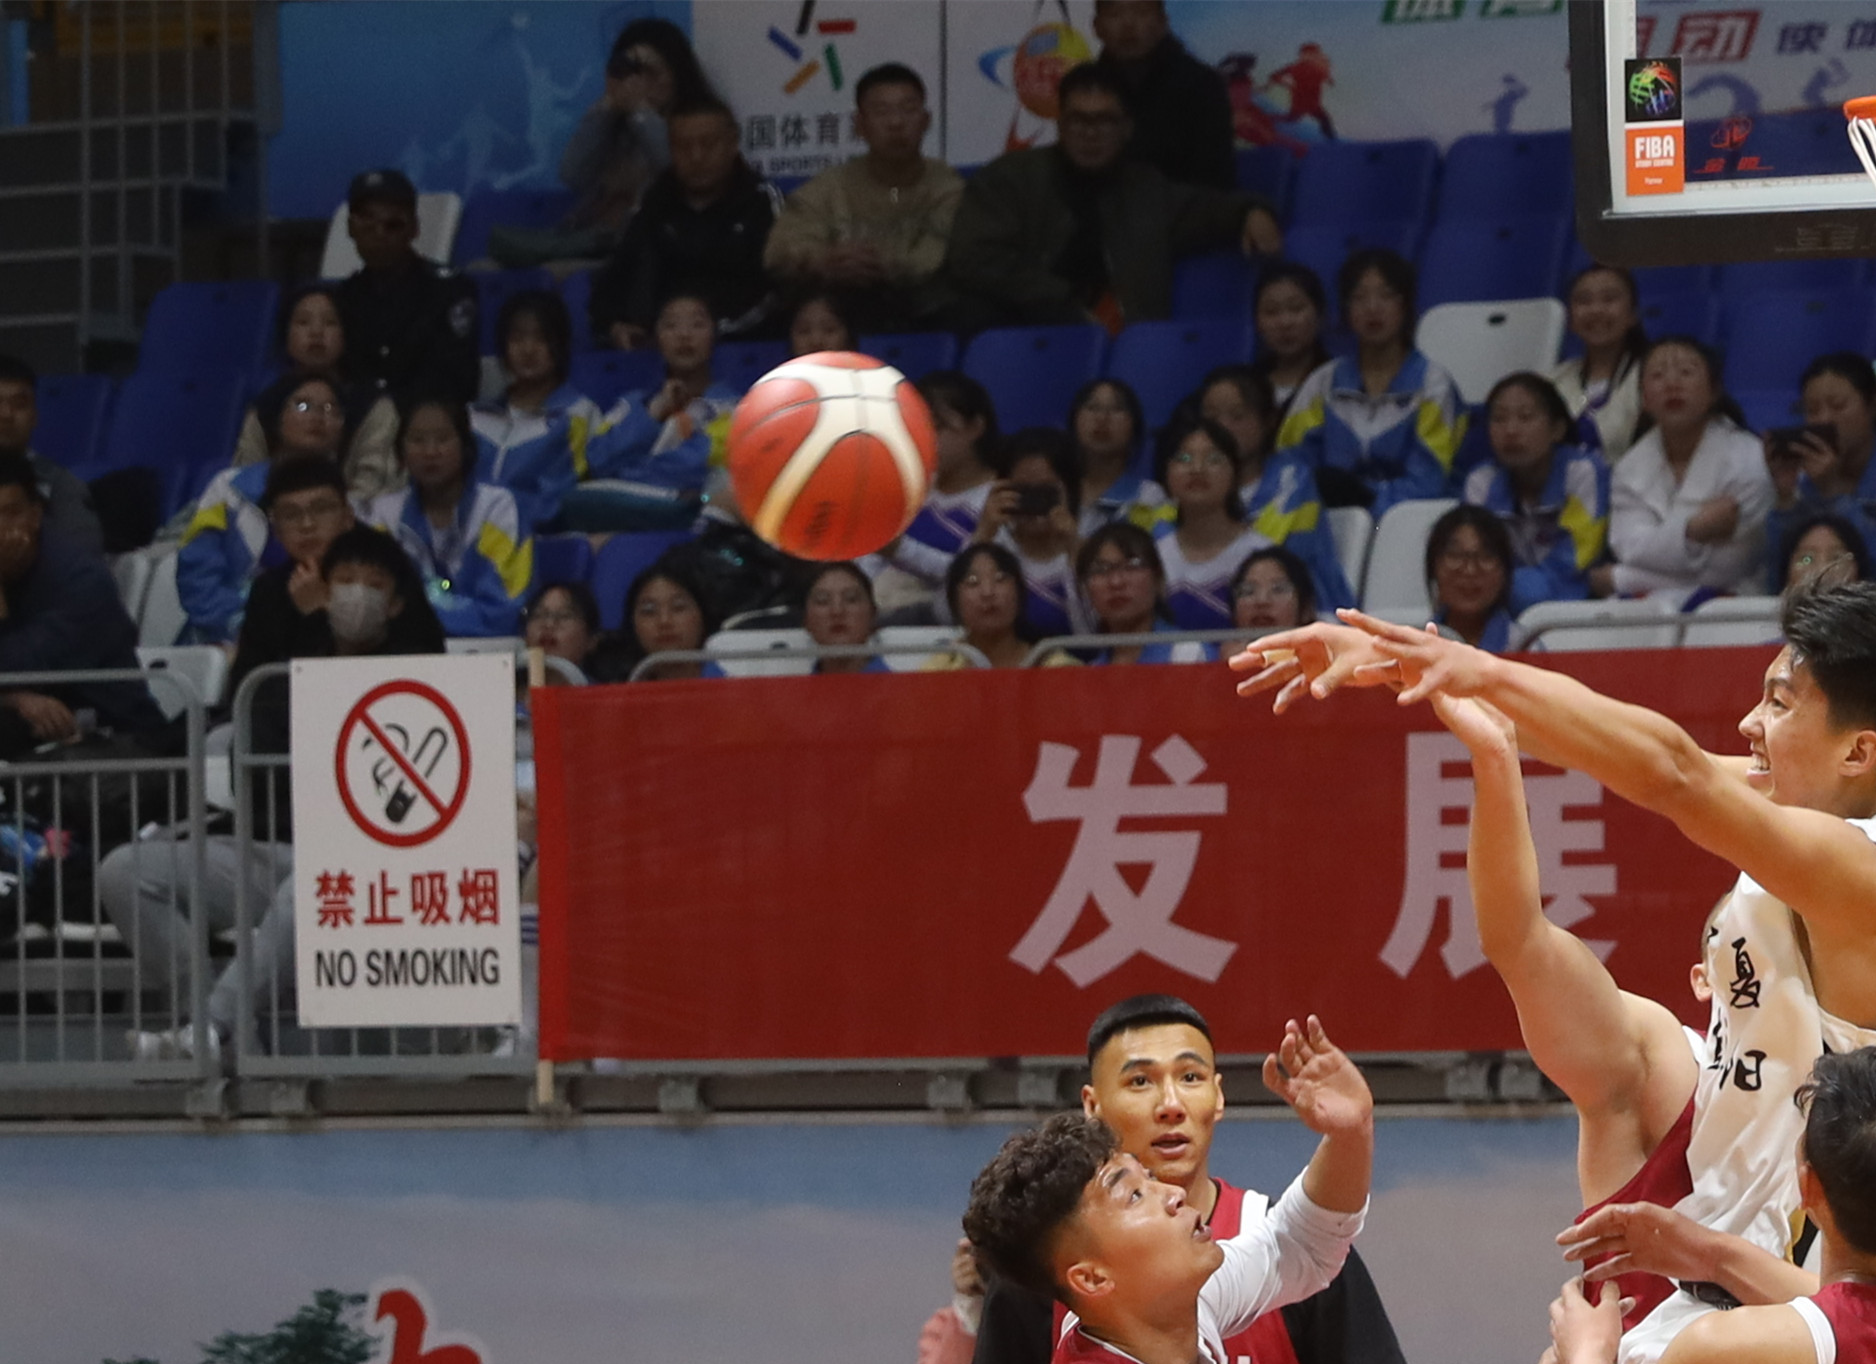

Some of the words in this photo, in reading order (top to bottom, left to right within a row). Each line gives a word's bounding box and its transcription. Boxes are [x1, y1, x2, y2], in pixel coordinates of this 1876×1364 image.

[1635, 134, 1676, 159] FIBA
[315, 868, 501, 928] 禁止吸烟
[316, 950, 357, 988] NO
[366, 948, 500, 987] SMOKING
